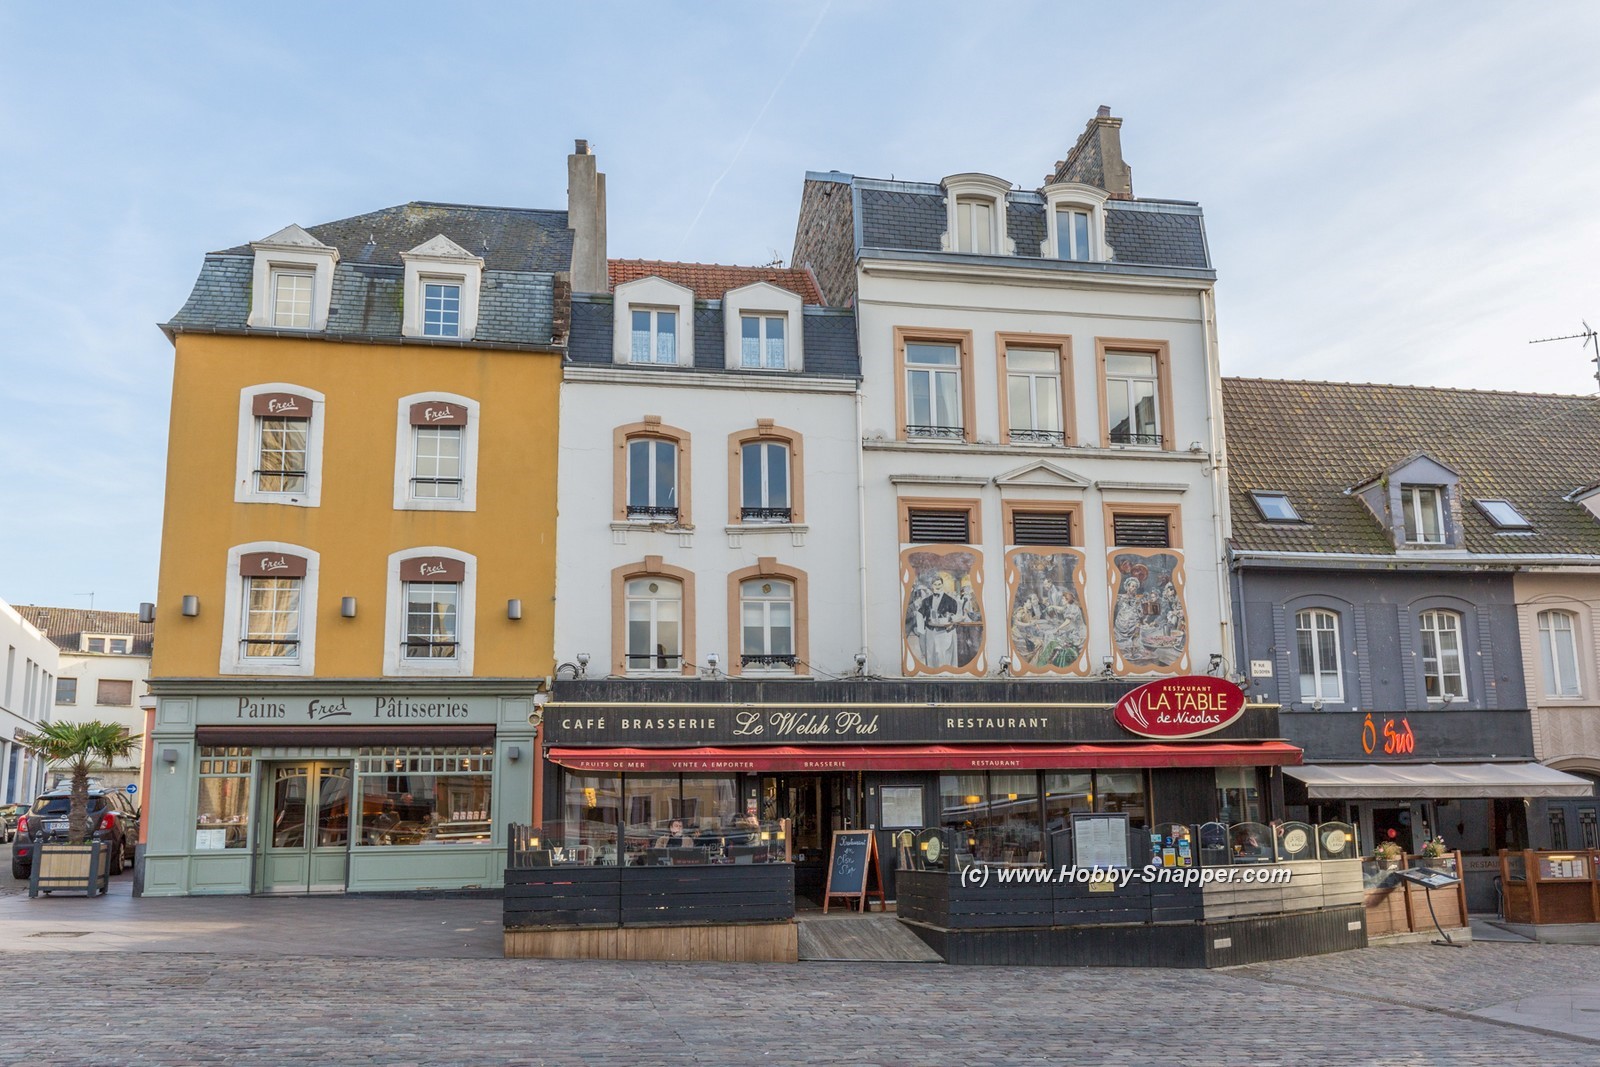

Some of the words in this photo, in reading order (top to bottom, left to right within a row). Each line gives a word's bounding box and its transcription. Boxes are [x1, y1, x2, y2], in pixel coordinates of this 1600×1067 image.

[236, 696, 286, 719] Pains
[374, 696, 469, 719] Pâtisseries
[1147, 692, 1171, 711] LA
[1174, 692, 1227, 711] TABLE
[562, 717, 605, 730] CAFÉ
[621, 718, 715, 730] BRASSERIE
[732, 711, 765, 736] Le
[769, 712, 831, 736] Welsh
[835, 711, 880, 735] Pub
[947, 717, 1048, 729] RESTAURANT
[1156, 711, 1172, 724] de
[1173, 710, 1220, 724] Nicolas
[1383, 717, 1415, 754] Sud
[804, 760, 846, 768] BRASSERIE
